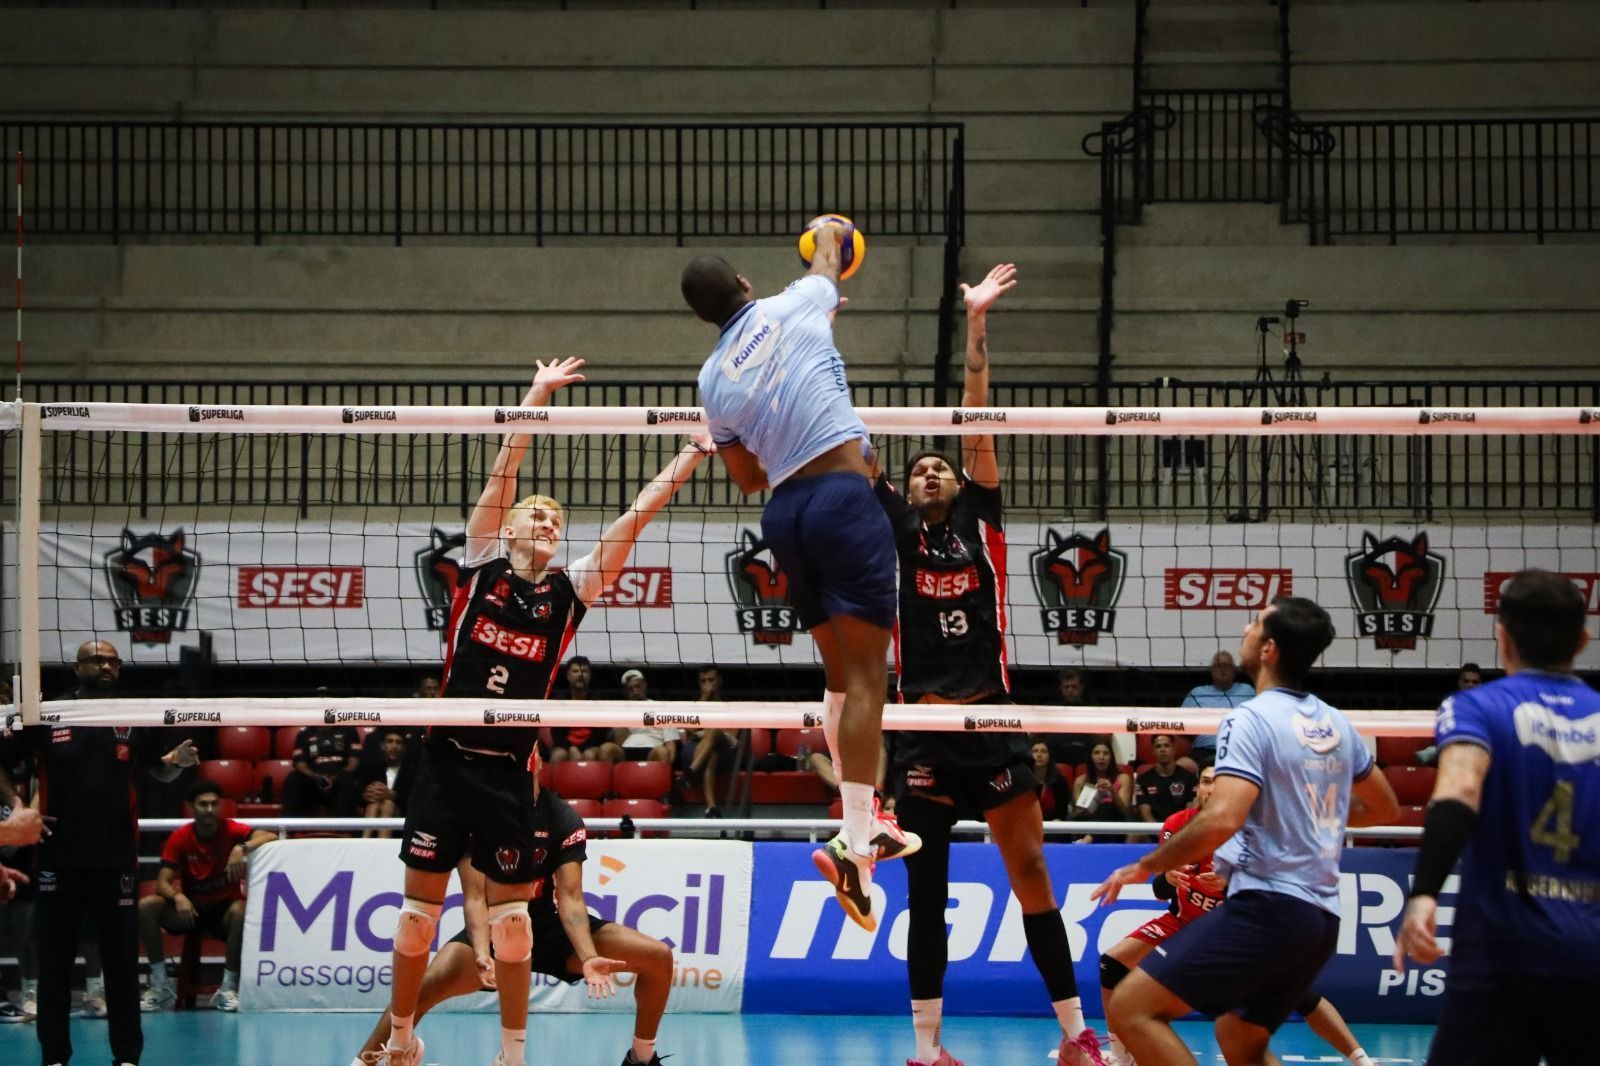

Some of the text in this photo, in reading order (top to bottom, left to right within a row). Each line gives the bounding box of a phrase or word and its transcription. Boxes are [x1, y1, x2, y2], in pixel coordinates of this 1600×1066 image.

[47, 407, 91, 418] SUPERLIGA
[202, 409, 245, 421] SUPERLIGA
[354, 410, 397, 422] SUPERLIGA
[506, 410, 549, 422] SUPERLIGA
[659, 410, 701, 423] SUPERLIGA
[964, 411, 1007, 423] SUPERLIGA
[1118, 411, 1161, 423] SUPERLIGA
[1274, 411, 1317, 423] SUPERLIGA
[1432, 412, 1476, 423] SUPERLIGA
[248, 571, 352, 606] SESI
[1176, 572, 1280, 607] SESI
[120, 608, 183, 628] SESI
[939, 609, 969, 638] 13
[1047, 609, 1110, 630] SESI
[1363, 613, 1428, 634] SESI
[477, 621, 542, 659] SESI
[486, 664, 509, 695] 2
[177, 710, 222, 723] SUPERLIGA
[337, 711, 382, 723] SUPERLIGA
[497, 711, 541, 724] SUPERLIGA
[656, 714, 701, 726] SUPERLIGA
[977, 717, 1023, 730] SUPERLIGA
[1139, 720, 1185, 731] SUPERLIGA
[1530, 778, 1580, 863] 4
